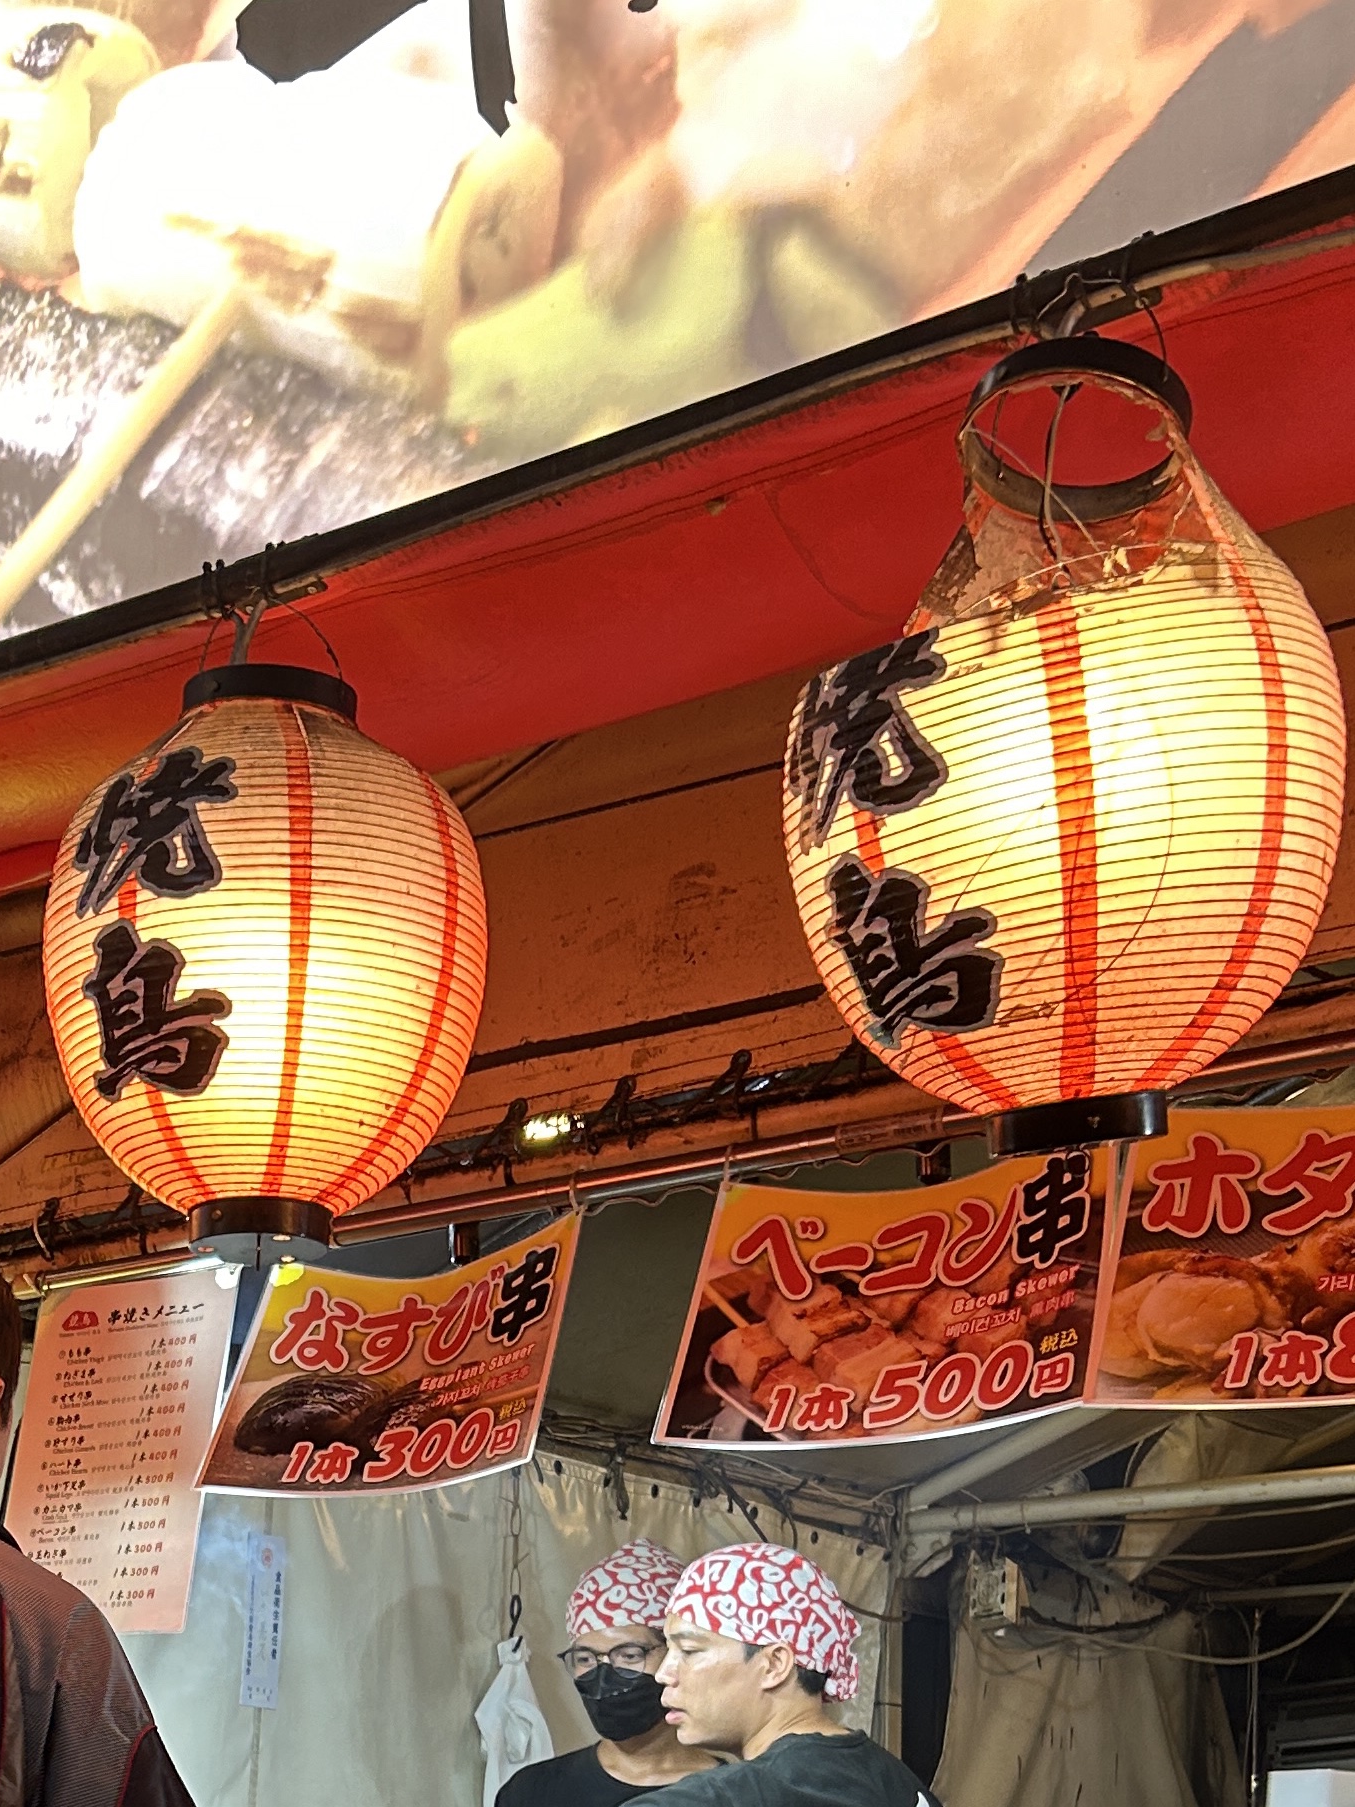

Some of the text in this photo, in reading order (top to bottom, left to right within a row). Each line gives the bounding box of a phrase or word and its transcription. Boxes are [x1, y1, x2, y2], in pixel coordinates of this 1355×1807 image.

[787, 626, 1004, 1049] 焼鳥
[73, 746, 237, 1102] 焼鳥
[733, 1154, 1090, 1299] ベーコン串
[272, 1243, 560, 1374] なすび串
[953, 1264, 1080, 1315] Bacon Skewer
[419, 1343, 536, 1391] Eggplant Skewer
[1040, 1328, 1078, 1354] 税込
[499, 1398, 527, 1420] 税込
